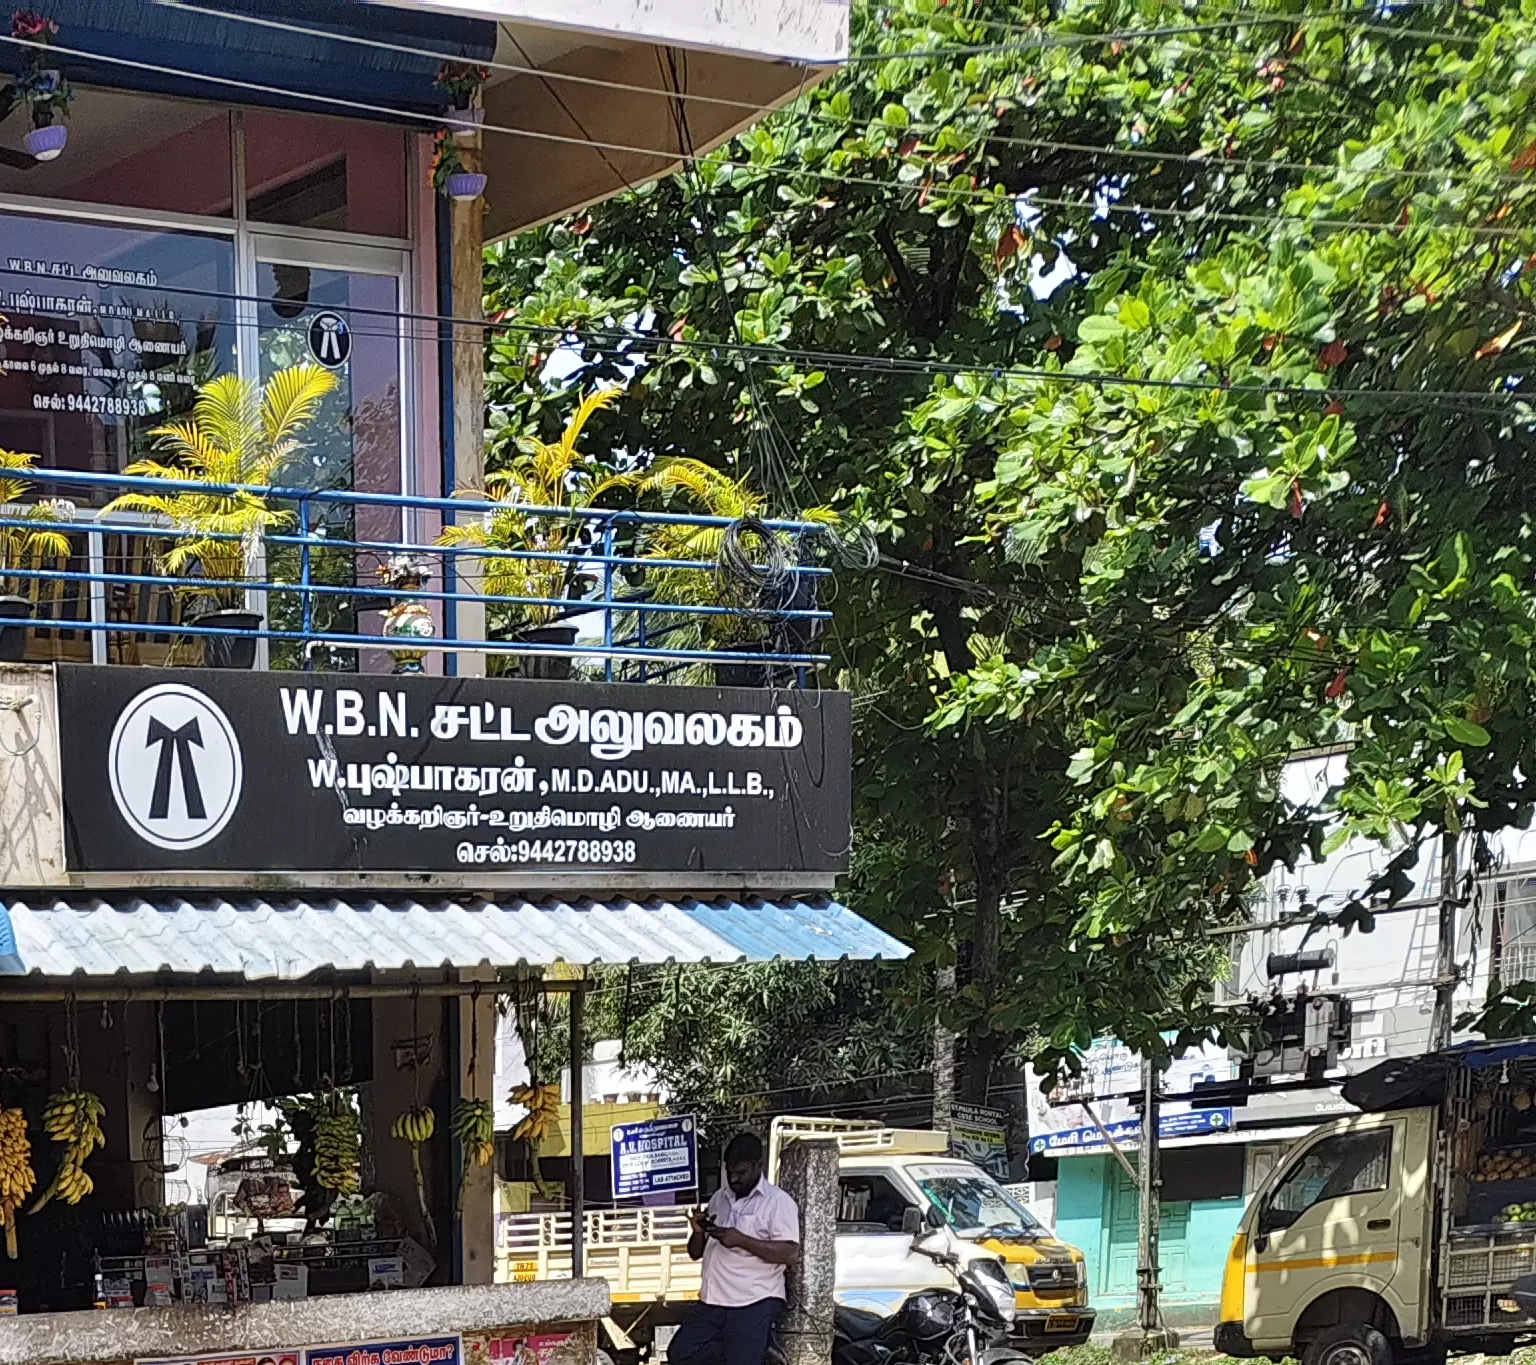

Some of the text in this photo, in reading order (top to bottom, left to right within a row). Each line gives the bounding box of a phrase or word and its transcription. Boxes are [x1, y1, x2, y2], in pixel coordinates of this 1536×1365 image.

[66, 395, 147, 417] 9442788938
[280, 688, 803, 760] W.B.N. சட்ட அலுவலகம்
[625, 806, 736, 830] ஆணையர்
[382, 1343, 455, 1365] வேண்டுமா?
